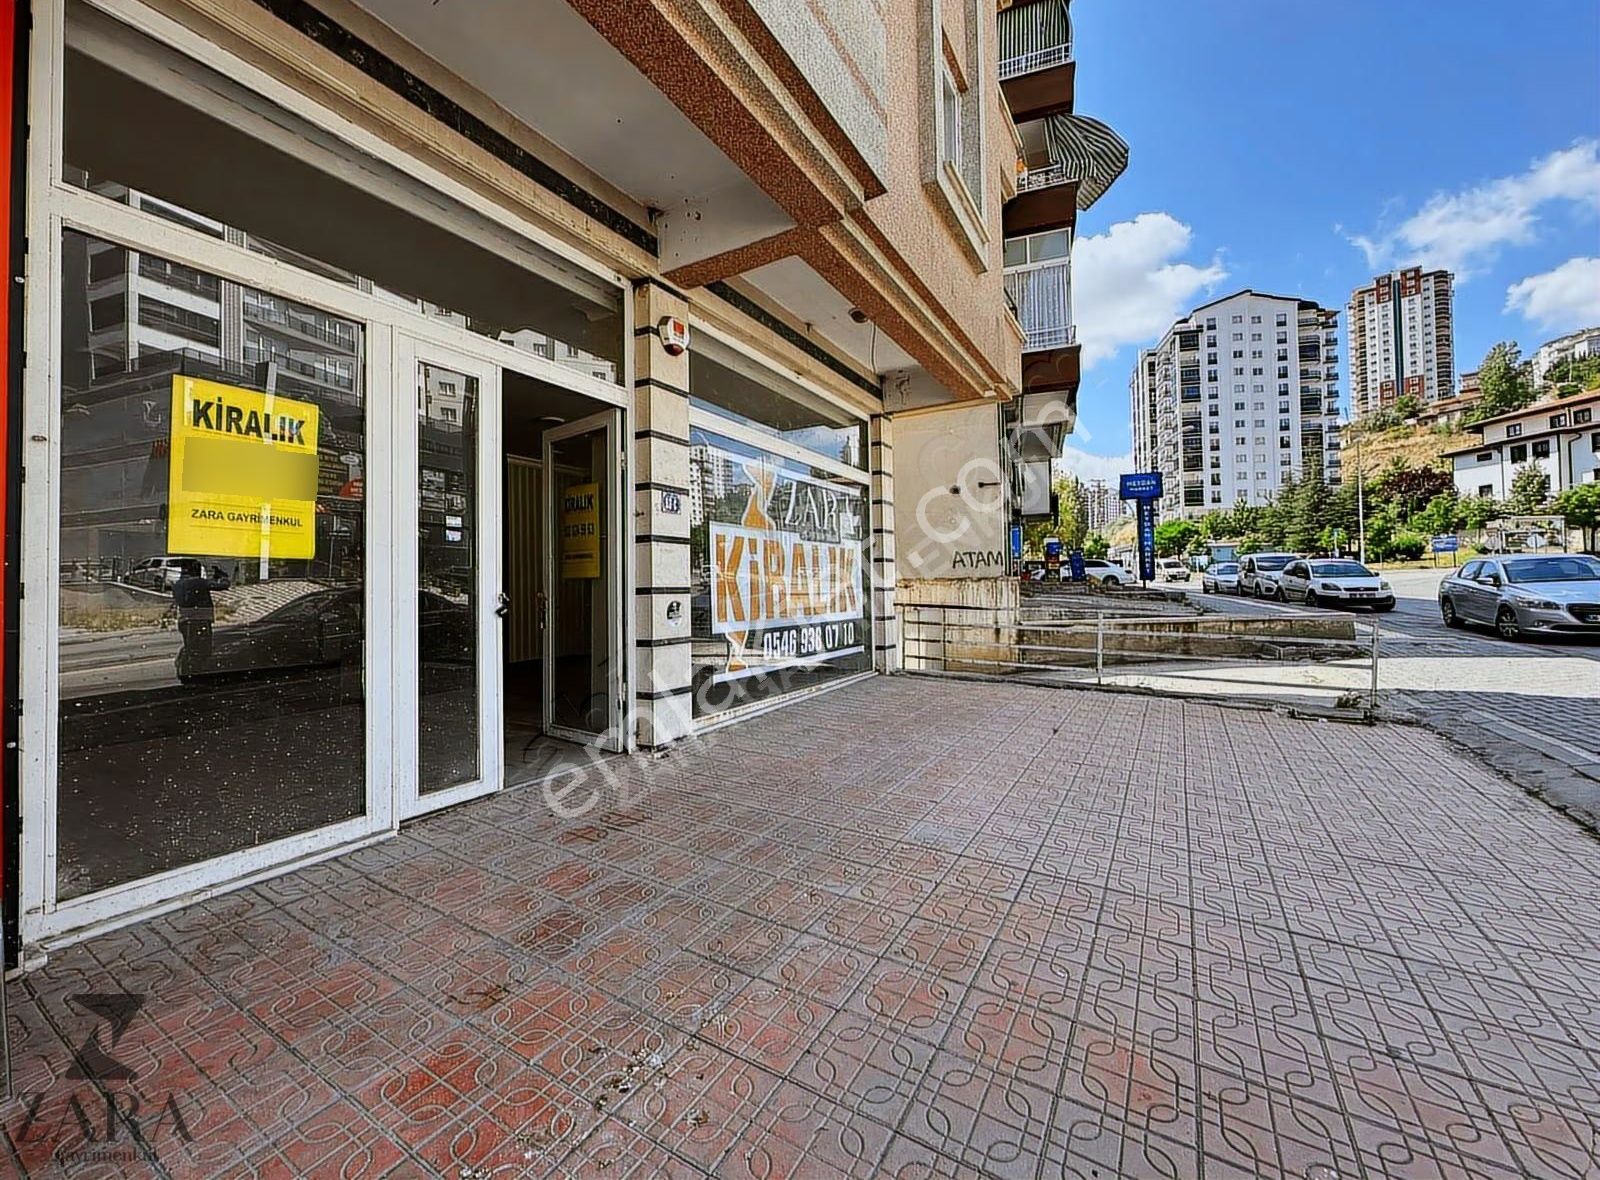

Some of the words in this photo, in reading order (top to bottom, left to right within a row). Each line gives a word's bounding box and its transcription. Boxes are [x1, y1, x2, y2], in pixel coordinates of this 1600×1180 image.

[192, 396, 306, 446] KİRALIK
[191, 508, 225, 520] ZARA
[715, 534, 857, 623] KİRALIK
[952, 550, 1004, 569] ATAM
[763, 629, 797, 660] 0546
[800, 626, 822, 653] 938
[825, 624, 839, 649] 07
[843, 622, 855, 645] 10
